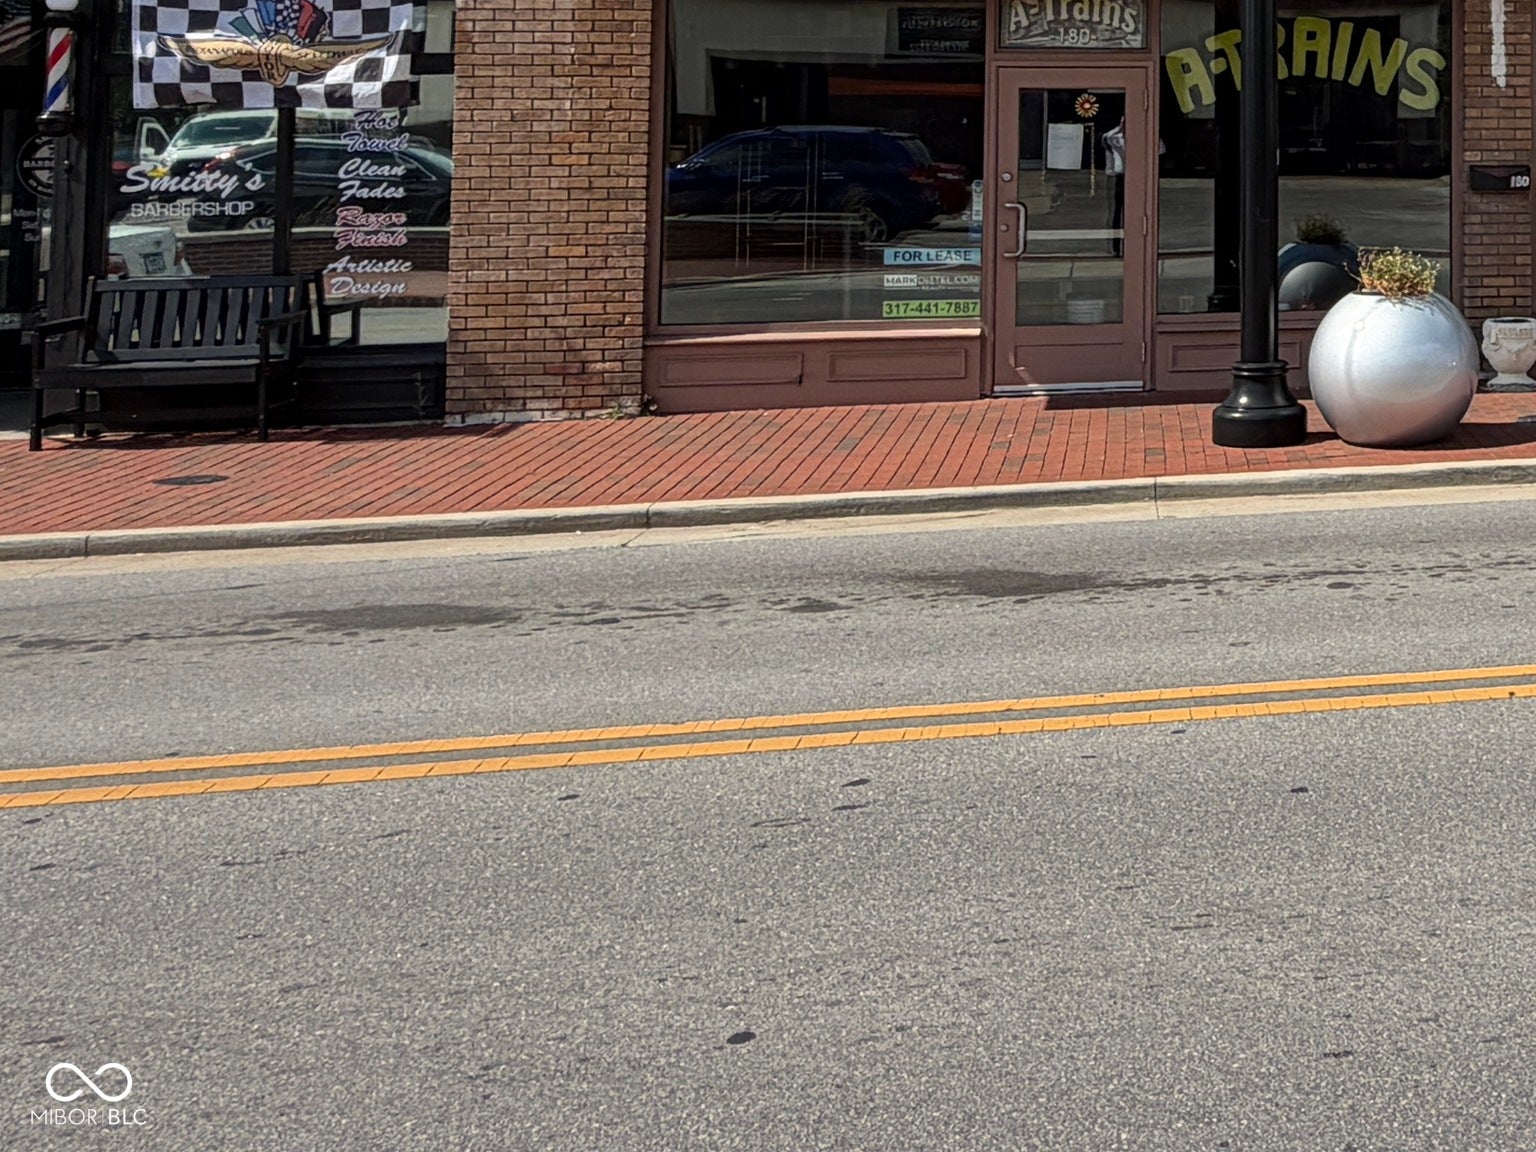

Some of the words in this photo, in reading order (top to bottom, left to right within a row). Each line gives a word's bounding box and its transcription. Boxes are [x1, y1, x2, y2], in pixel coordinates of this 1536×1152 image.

[1165, 16, 1446, 110] A-TAINS
[354, 110, 399, 129] Hot
[341, 130, 409, 152] Towel
[338, 158, 406, 179] Clean
[120, 162, 266, 198] Smitty's
[1511, 175, 1530, 187] 180
[338, 180, 406, 202] Fades
[131, 201, 255, 217] BARBERSHOP
[335, 206, 407, 229] Razor
[333, 227, 408, 250] Finish
[322, 255, 413, 275] Artistic
[893, 250, 922, 262] FOR
[926, 250, 973, 262] LEASE
[330, 276, 406, 299] Design
[884, 301, 979, 315] 317-441-7887
